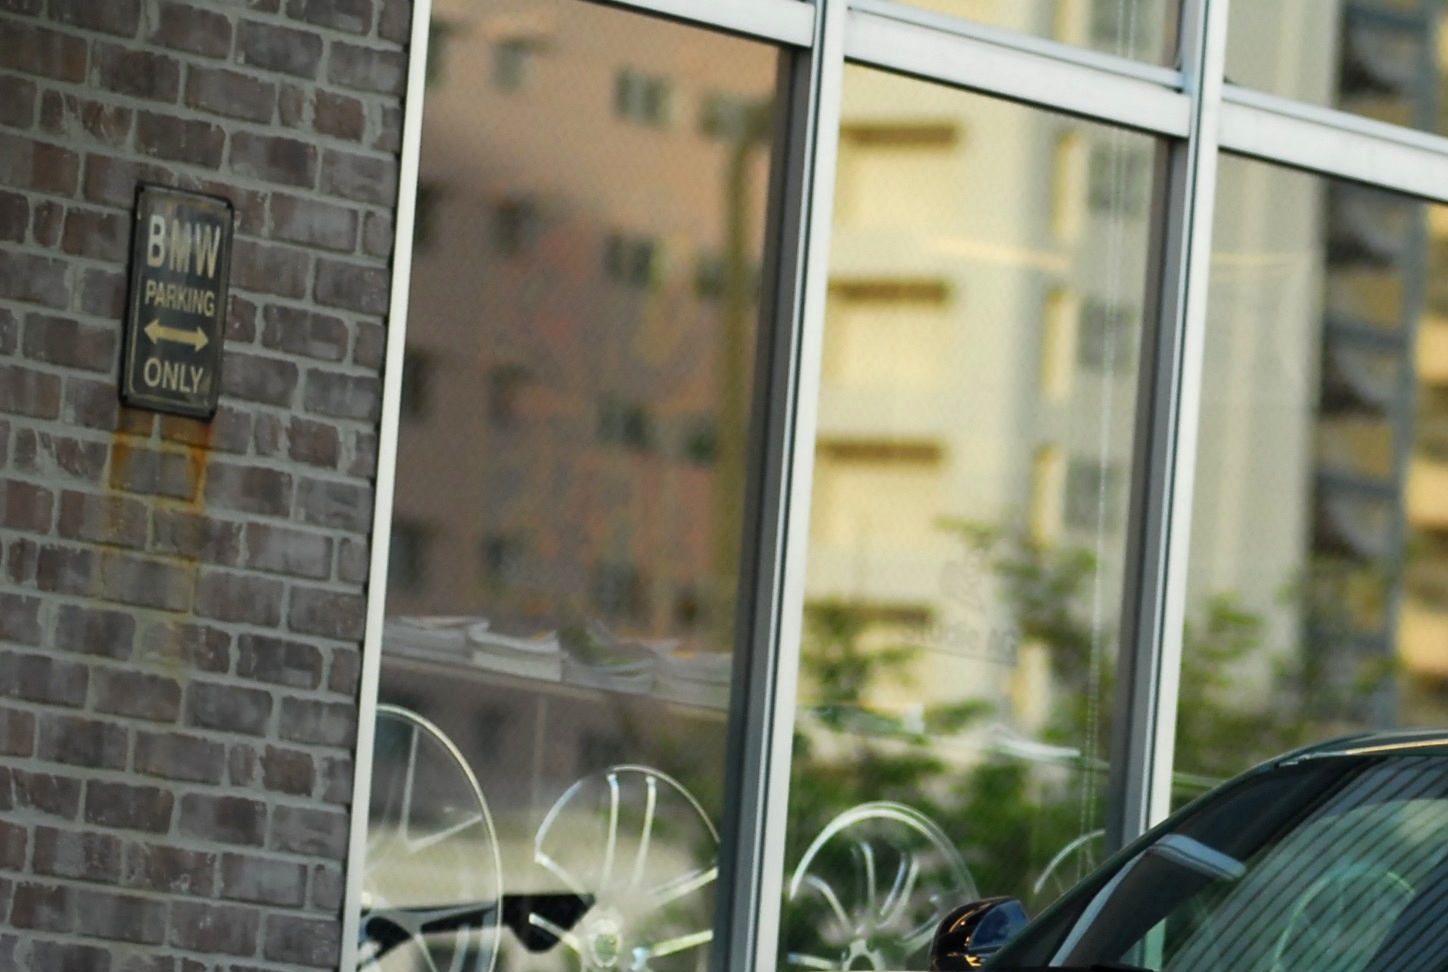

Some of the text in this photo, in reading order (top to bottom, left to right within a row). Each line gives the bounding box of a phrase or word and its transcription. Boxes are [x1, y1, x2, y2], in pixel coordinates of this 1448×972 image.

[147, 215, 220, 278] BMW
[145, 280, 215, 317] PARKING
[144, 358, 204, 393] ONLY
